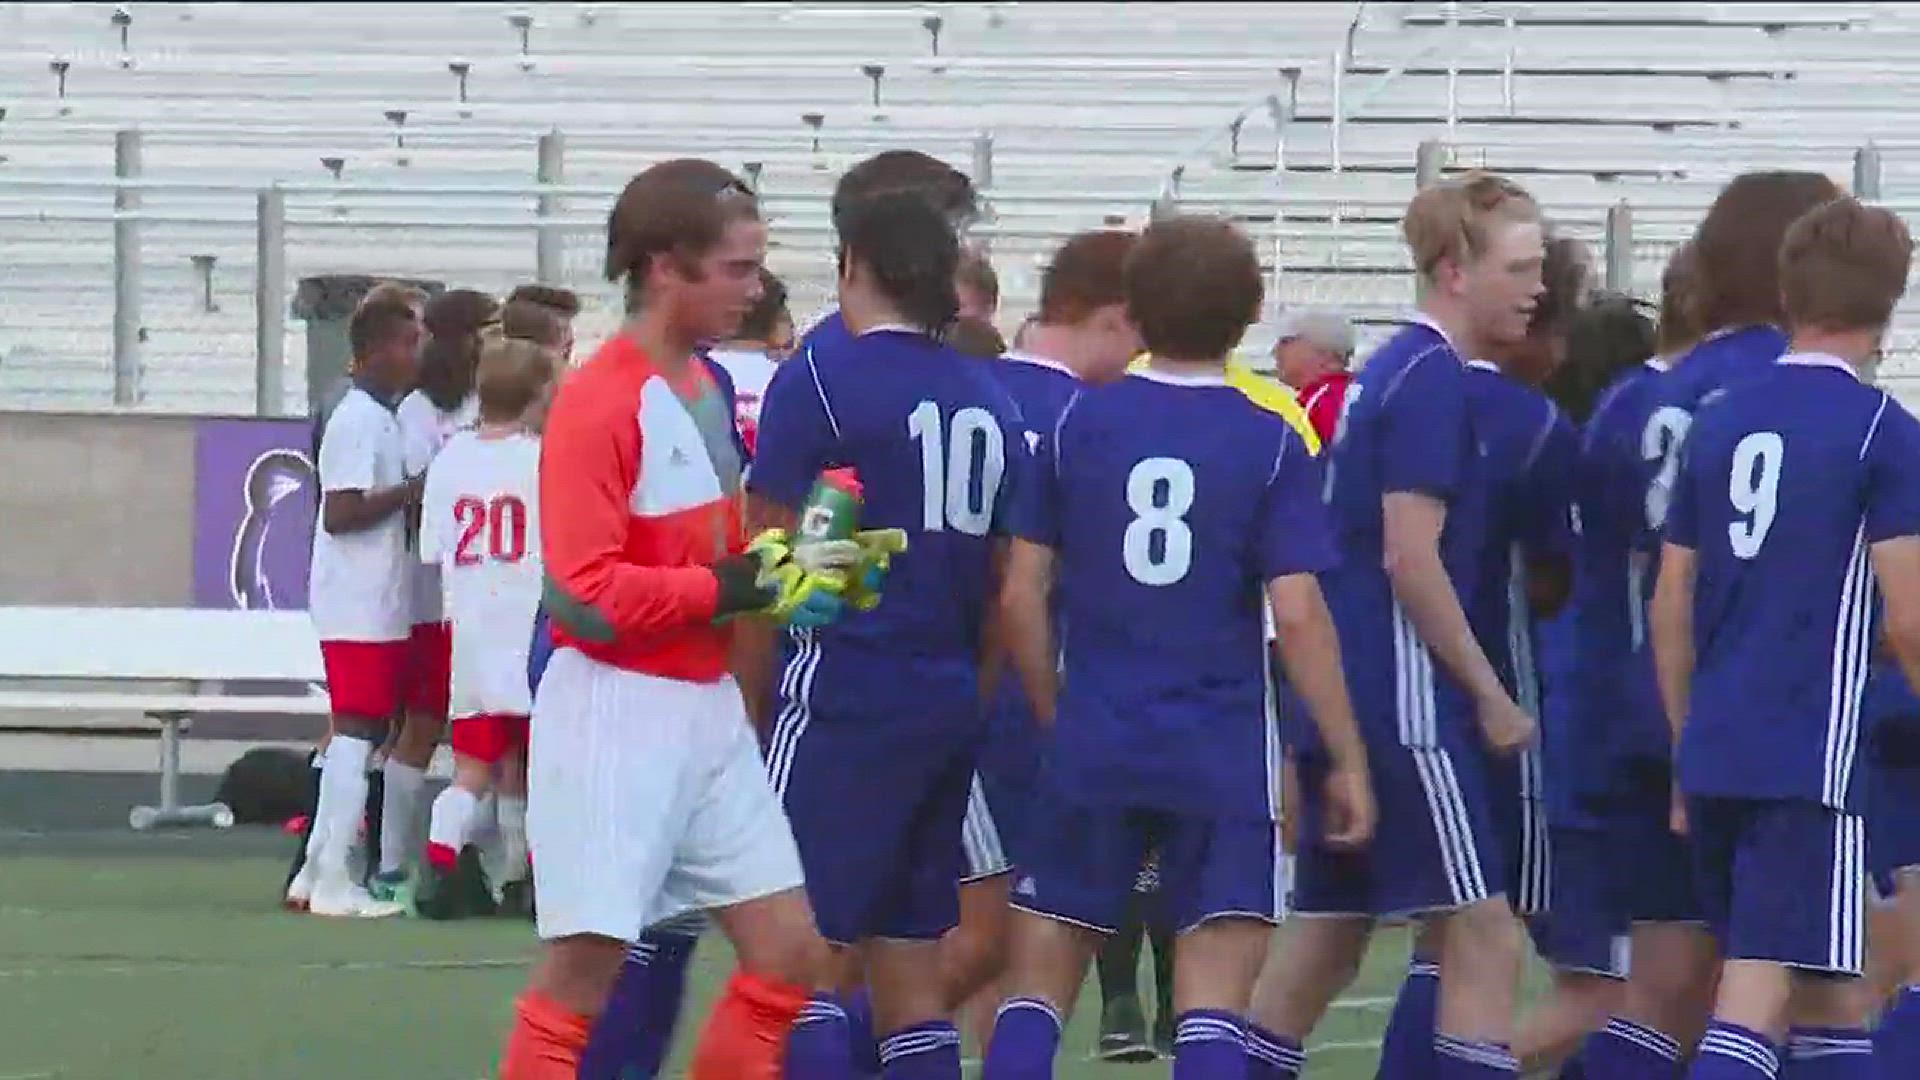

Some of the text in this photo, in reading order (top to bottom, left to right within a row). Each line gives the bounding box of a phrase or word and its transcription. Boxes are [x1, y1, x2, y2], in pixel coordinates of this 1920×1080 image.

[453, 494, 526, 566] 20
[908, 400, 1004, 536] 10
[1123, 456, 1194, 586] 8
[1729, 432, 1784, 560] 9
